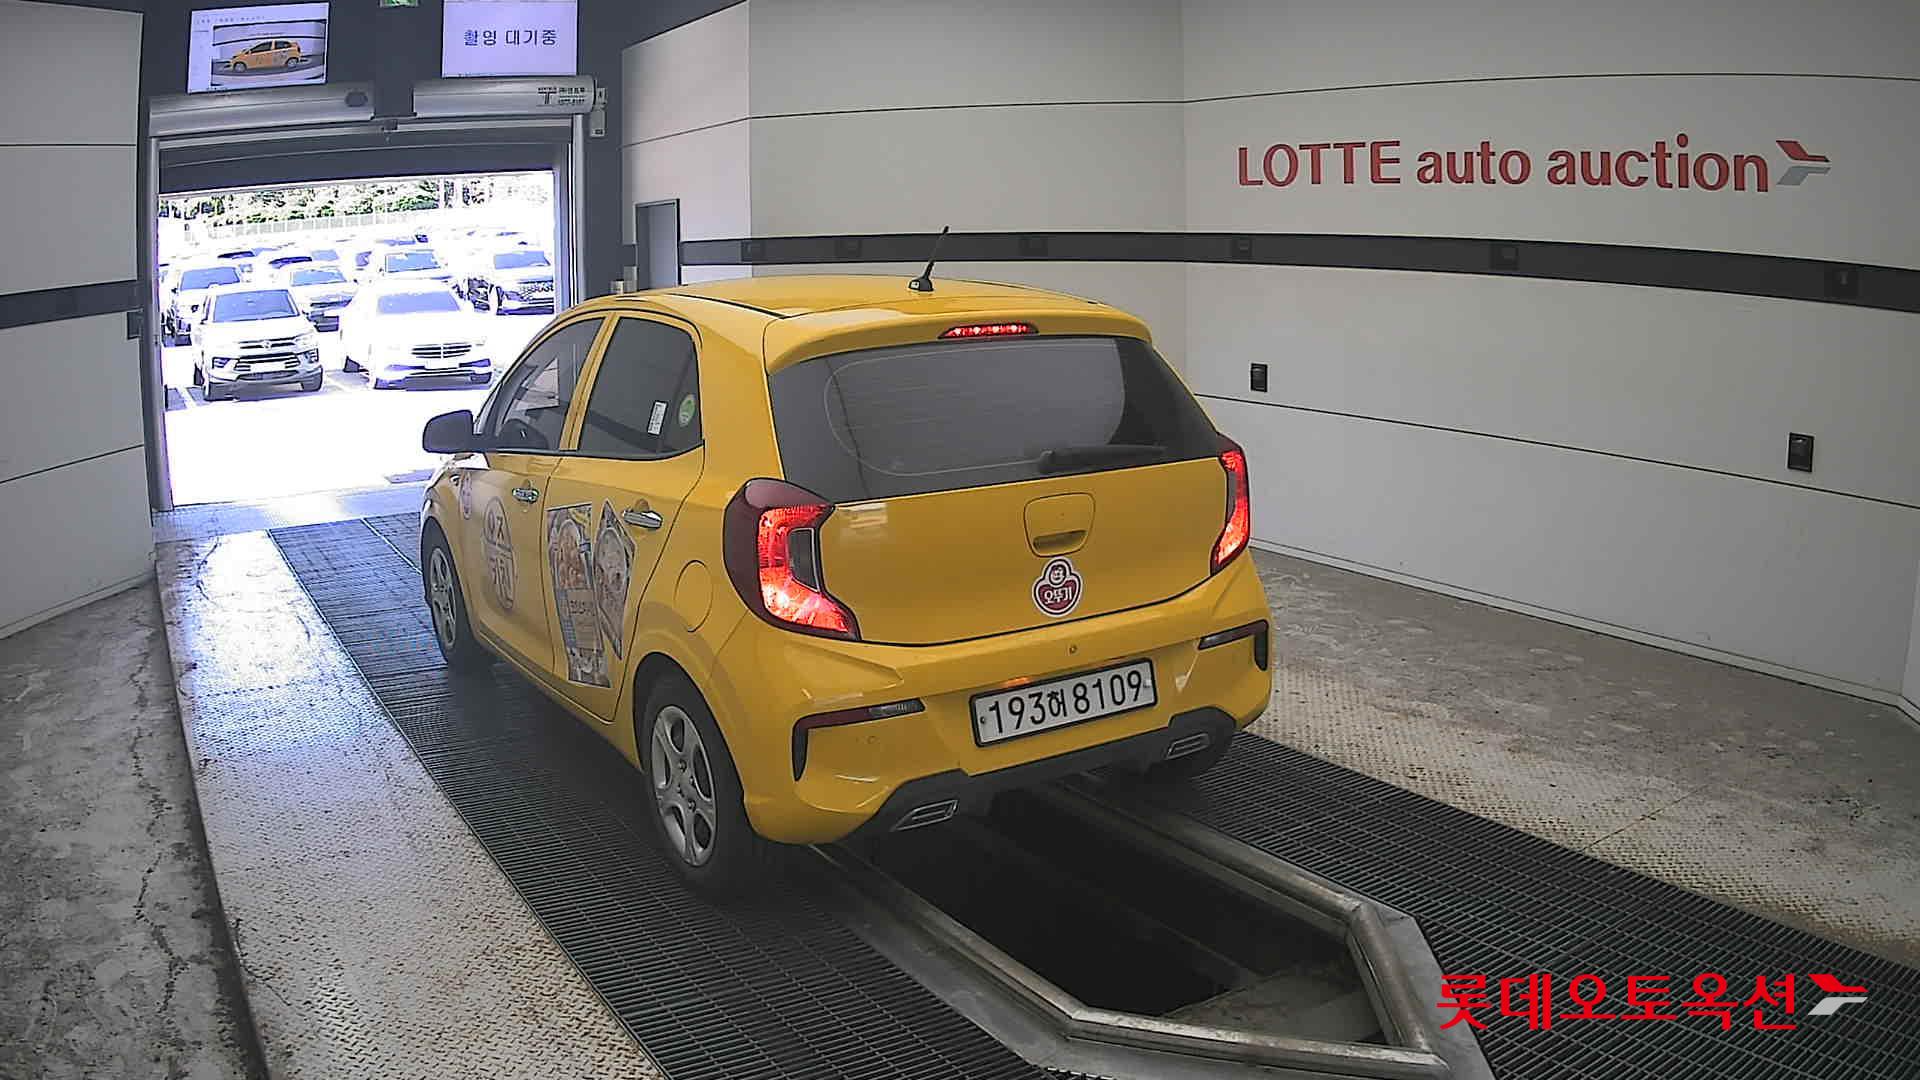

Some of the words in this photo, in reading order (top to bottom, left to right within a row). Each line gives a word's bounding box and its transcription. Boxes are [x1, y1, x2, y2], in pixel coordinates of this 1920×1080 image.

[505, 29, 558, 46] 대기중
[1239, 140, 1401, 186] LOTTE
[1417, 142, 1532, 185] auto
[1548, 134, 1769, 192] auction
[1044, 587, 1073, 604] 오뚜기
